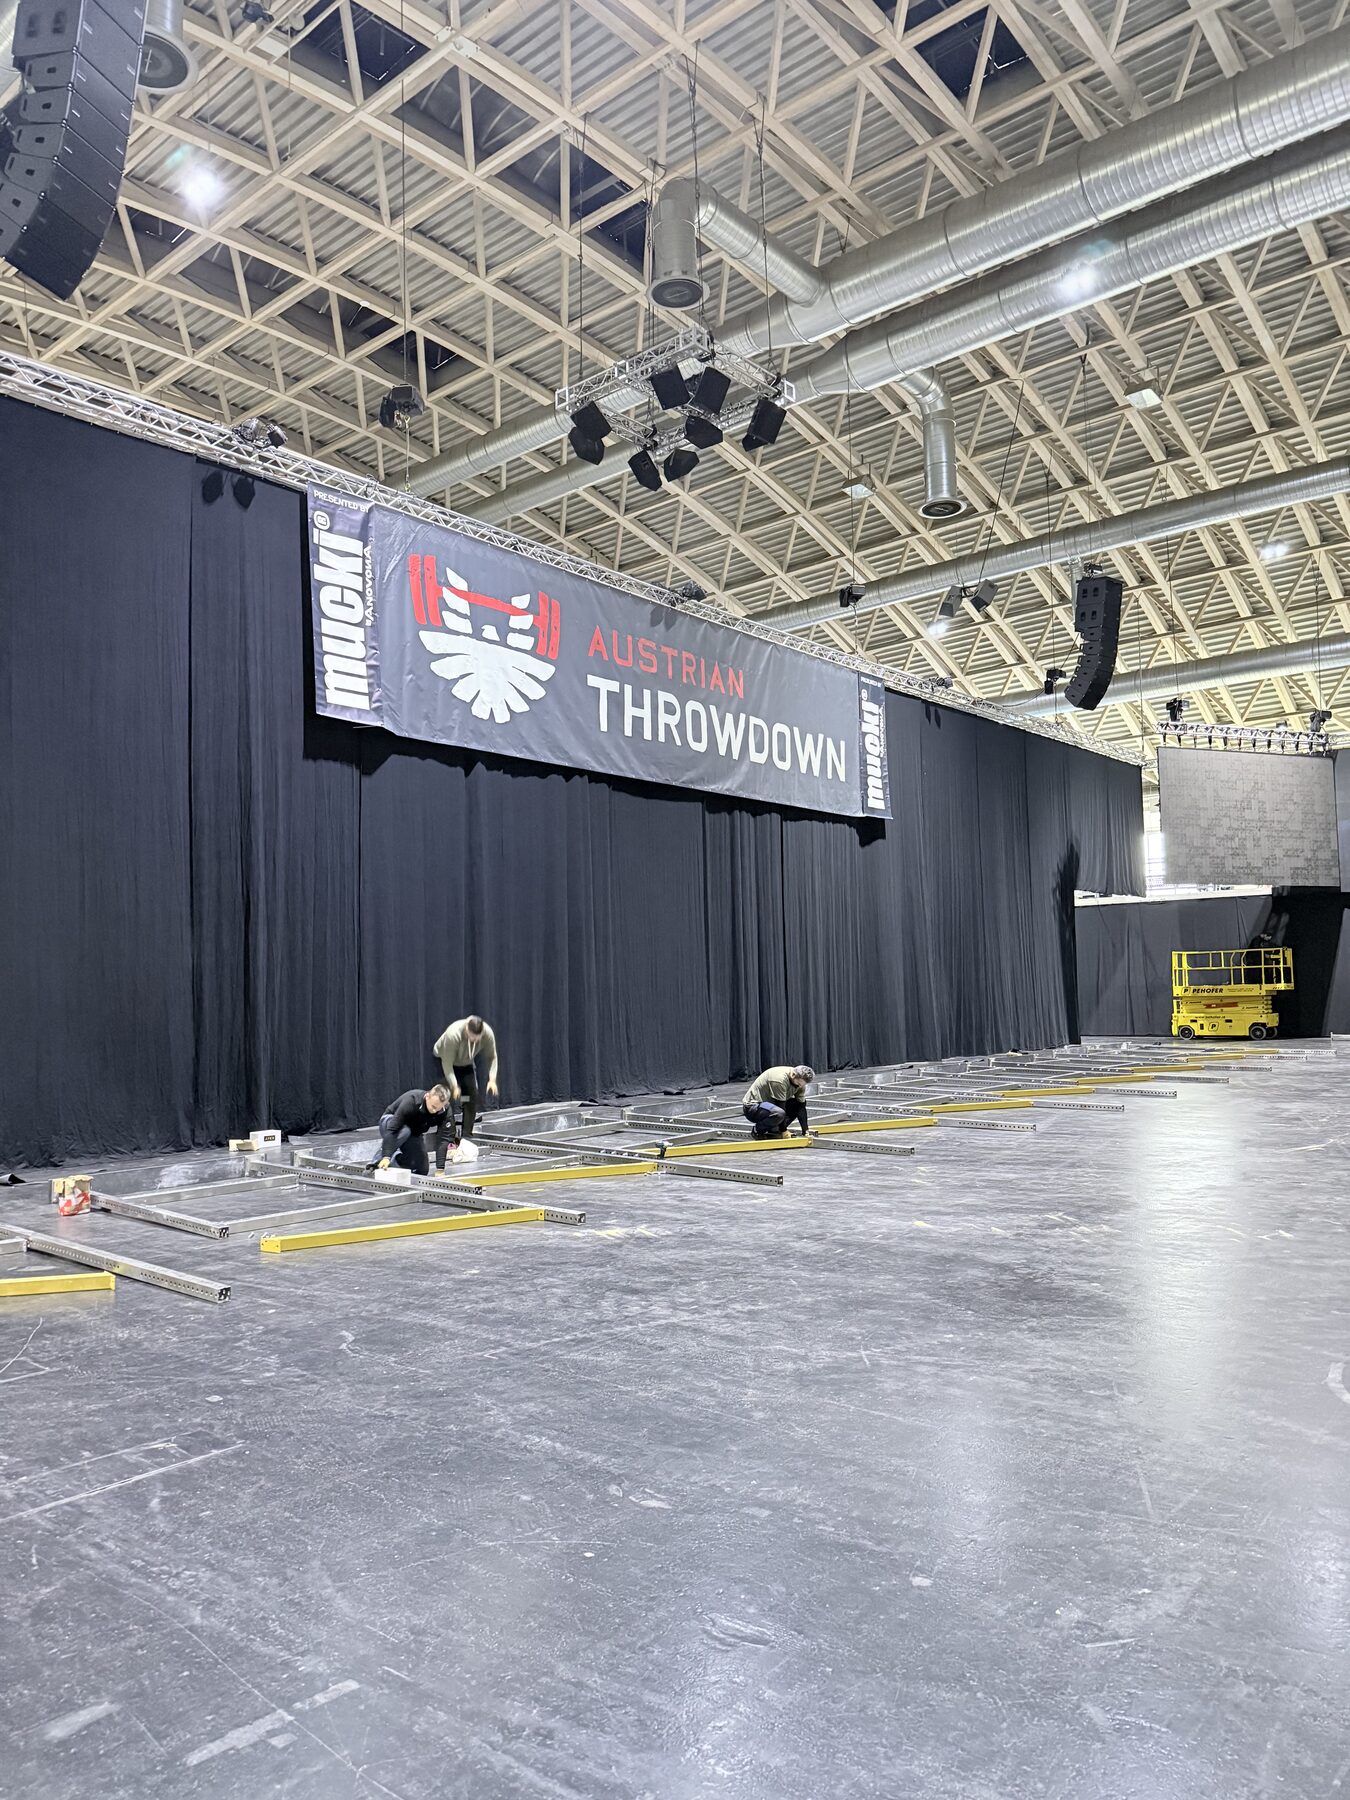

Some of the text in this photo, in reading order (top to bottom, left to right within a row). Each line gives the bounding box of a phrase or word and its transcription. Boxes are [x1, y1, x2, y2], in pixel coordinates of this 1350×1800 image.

[313, 490, 370, 513] PRESENTED BY
[587, 625, 744, 699] AUSTRIAN
[586, 674, 846, 783] THROWDOWN
